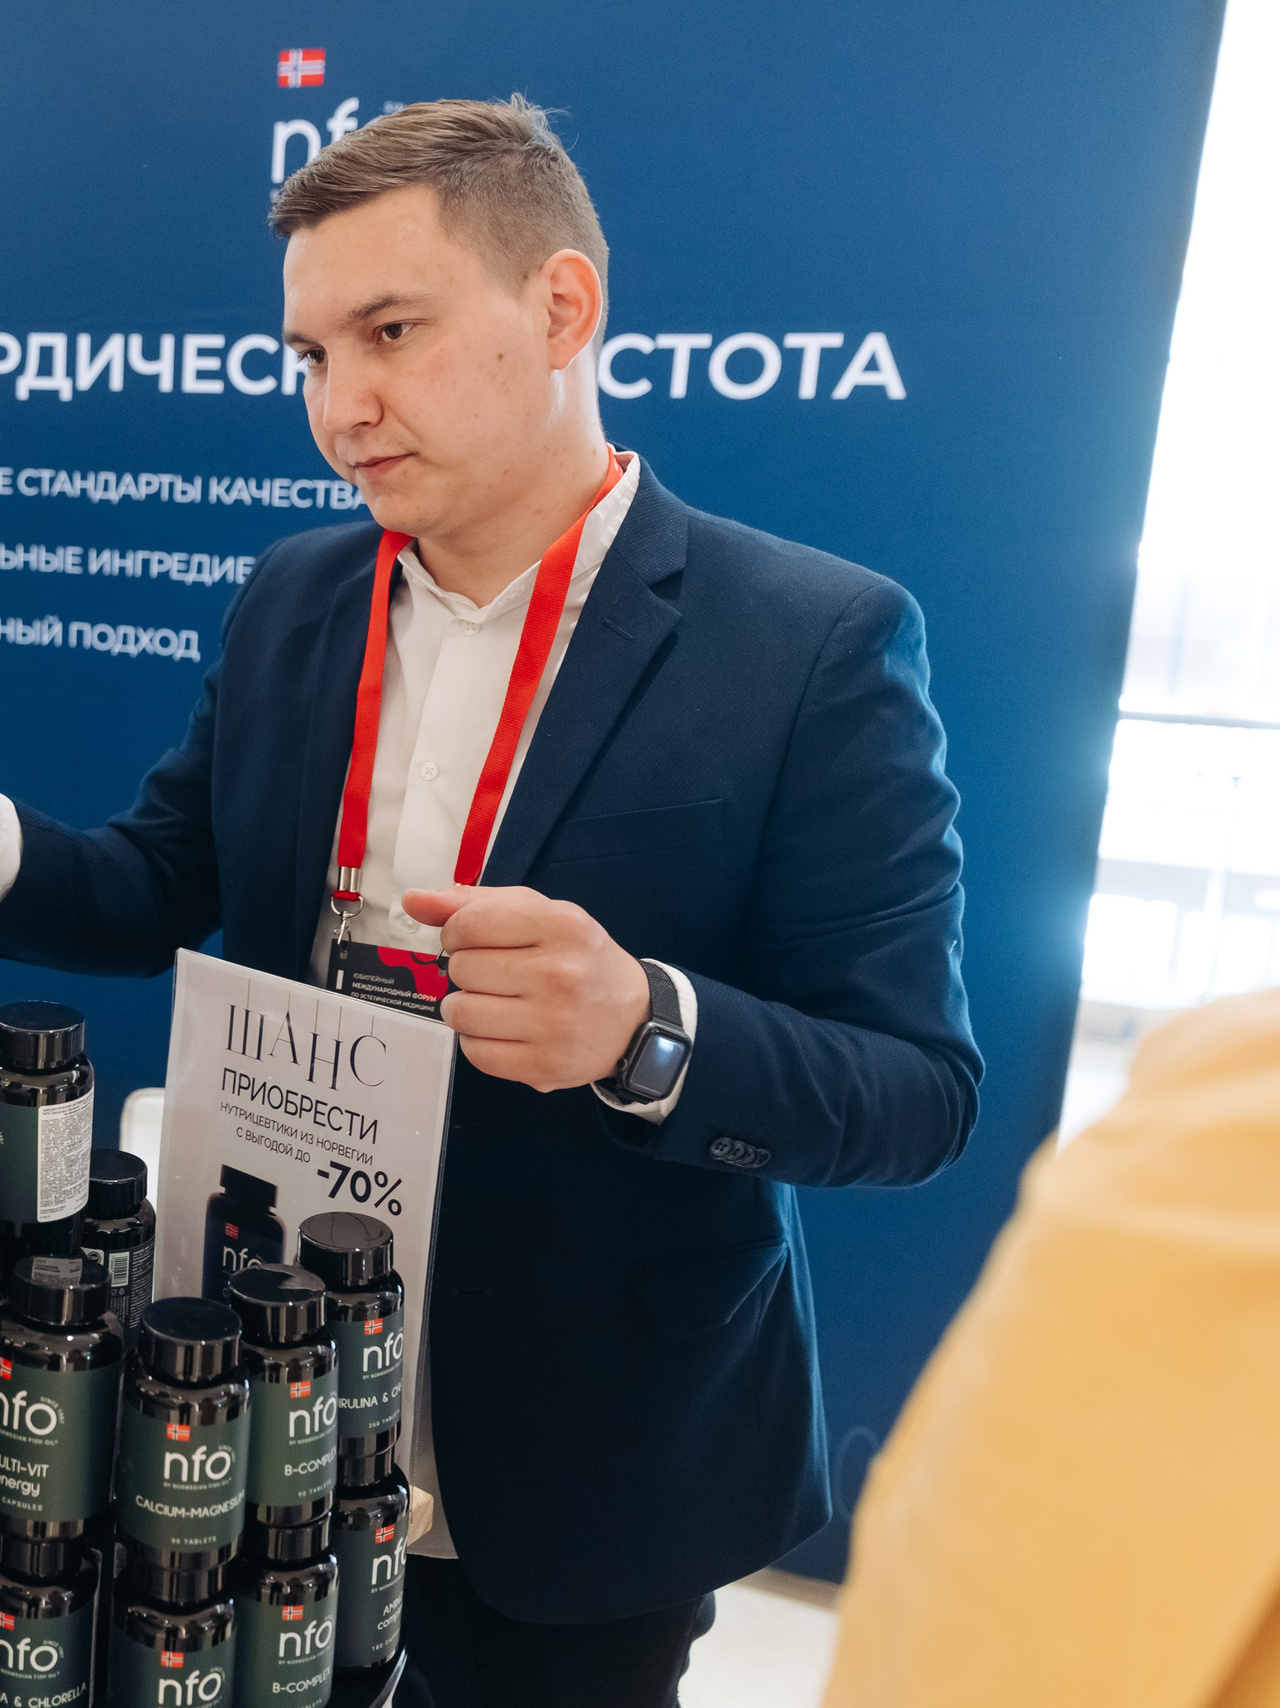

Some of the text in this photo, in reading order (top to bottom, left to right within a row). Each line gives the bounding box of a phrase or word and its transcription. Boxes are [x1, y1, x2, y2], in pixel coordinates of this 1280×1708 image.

[271, 97, 382, 183] nf
[597, 331, 908, 400] СТОТА
[16, 466, 202, 505] СТАНДАРТЫ
[87, 546, 256, 587] ИНГРЕДИЕ
[68, 620, 201, 664] ПОДХОД
[351, 982, 437, 1003] МЕЖДУНАРОДНЫЙ ФОРУМ
[353, 972, 395, 985] ЮБИЛЕЙНЫЙ
[359, 993, 402, 1006] ЭСТЕТИЧЕСКОЙ
[402, 1001, 436, 1013] МЕДИЦИНЕ
[224, 1003, 388, 1092] ШАНС
[221, 1067, 379, 1145] ПРИОБРЕСТИ
[220, 1101, 375, 1167] НУТРИЦЕВТИКИ ИЗ НОРВЕГИИ
[236, 1126, 312, 1164] С ВЫГОДОЙ ДО
[316, 1159, 403, 1217] -70%
[362, 1331, 404, 1372] nfo
[289, 1395, 337, 1438] nfo
[338, 1392, 389, 1409] IRULINA &
[163, 1445, 231, 1483] nfo
[1, 1496, 43, 1512] CAPSULES
[184, 1535, 217, 1545] TABLETS
[278, 1620, 332, 1658] nfo
[27, 1681, 87, 1708] CHLORELLA
[158, 1669, 222, 1707] nfo
